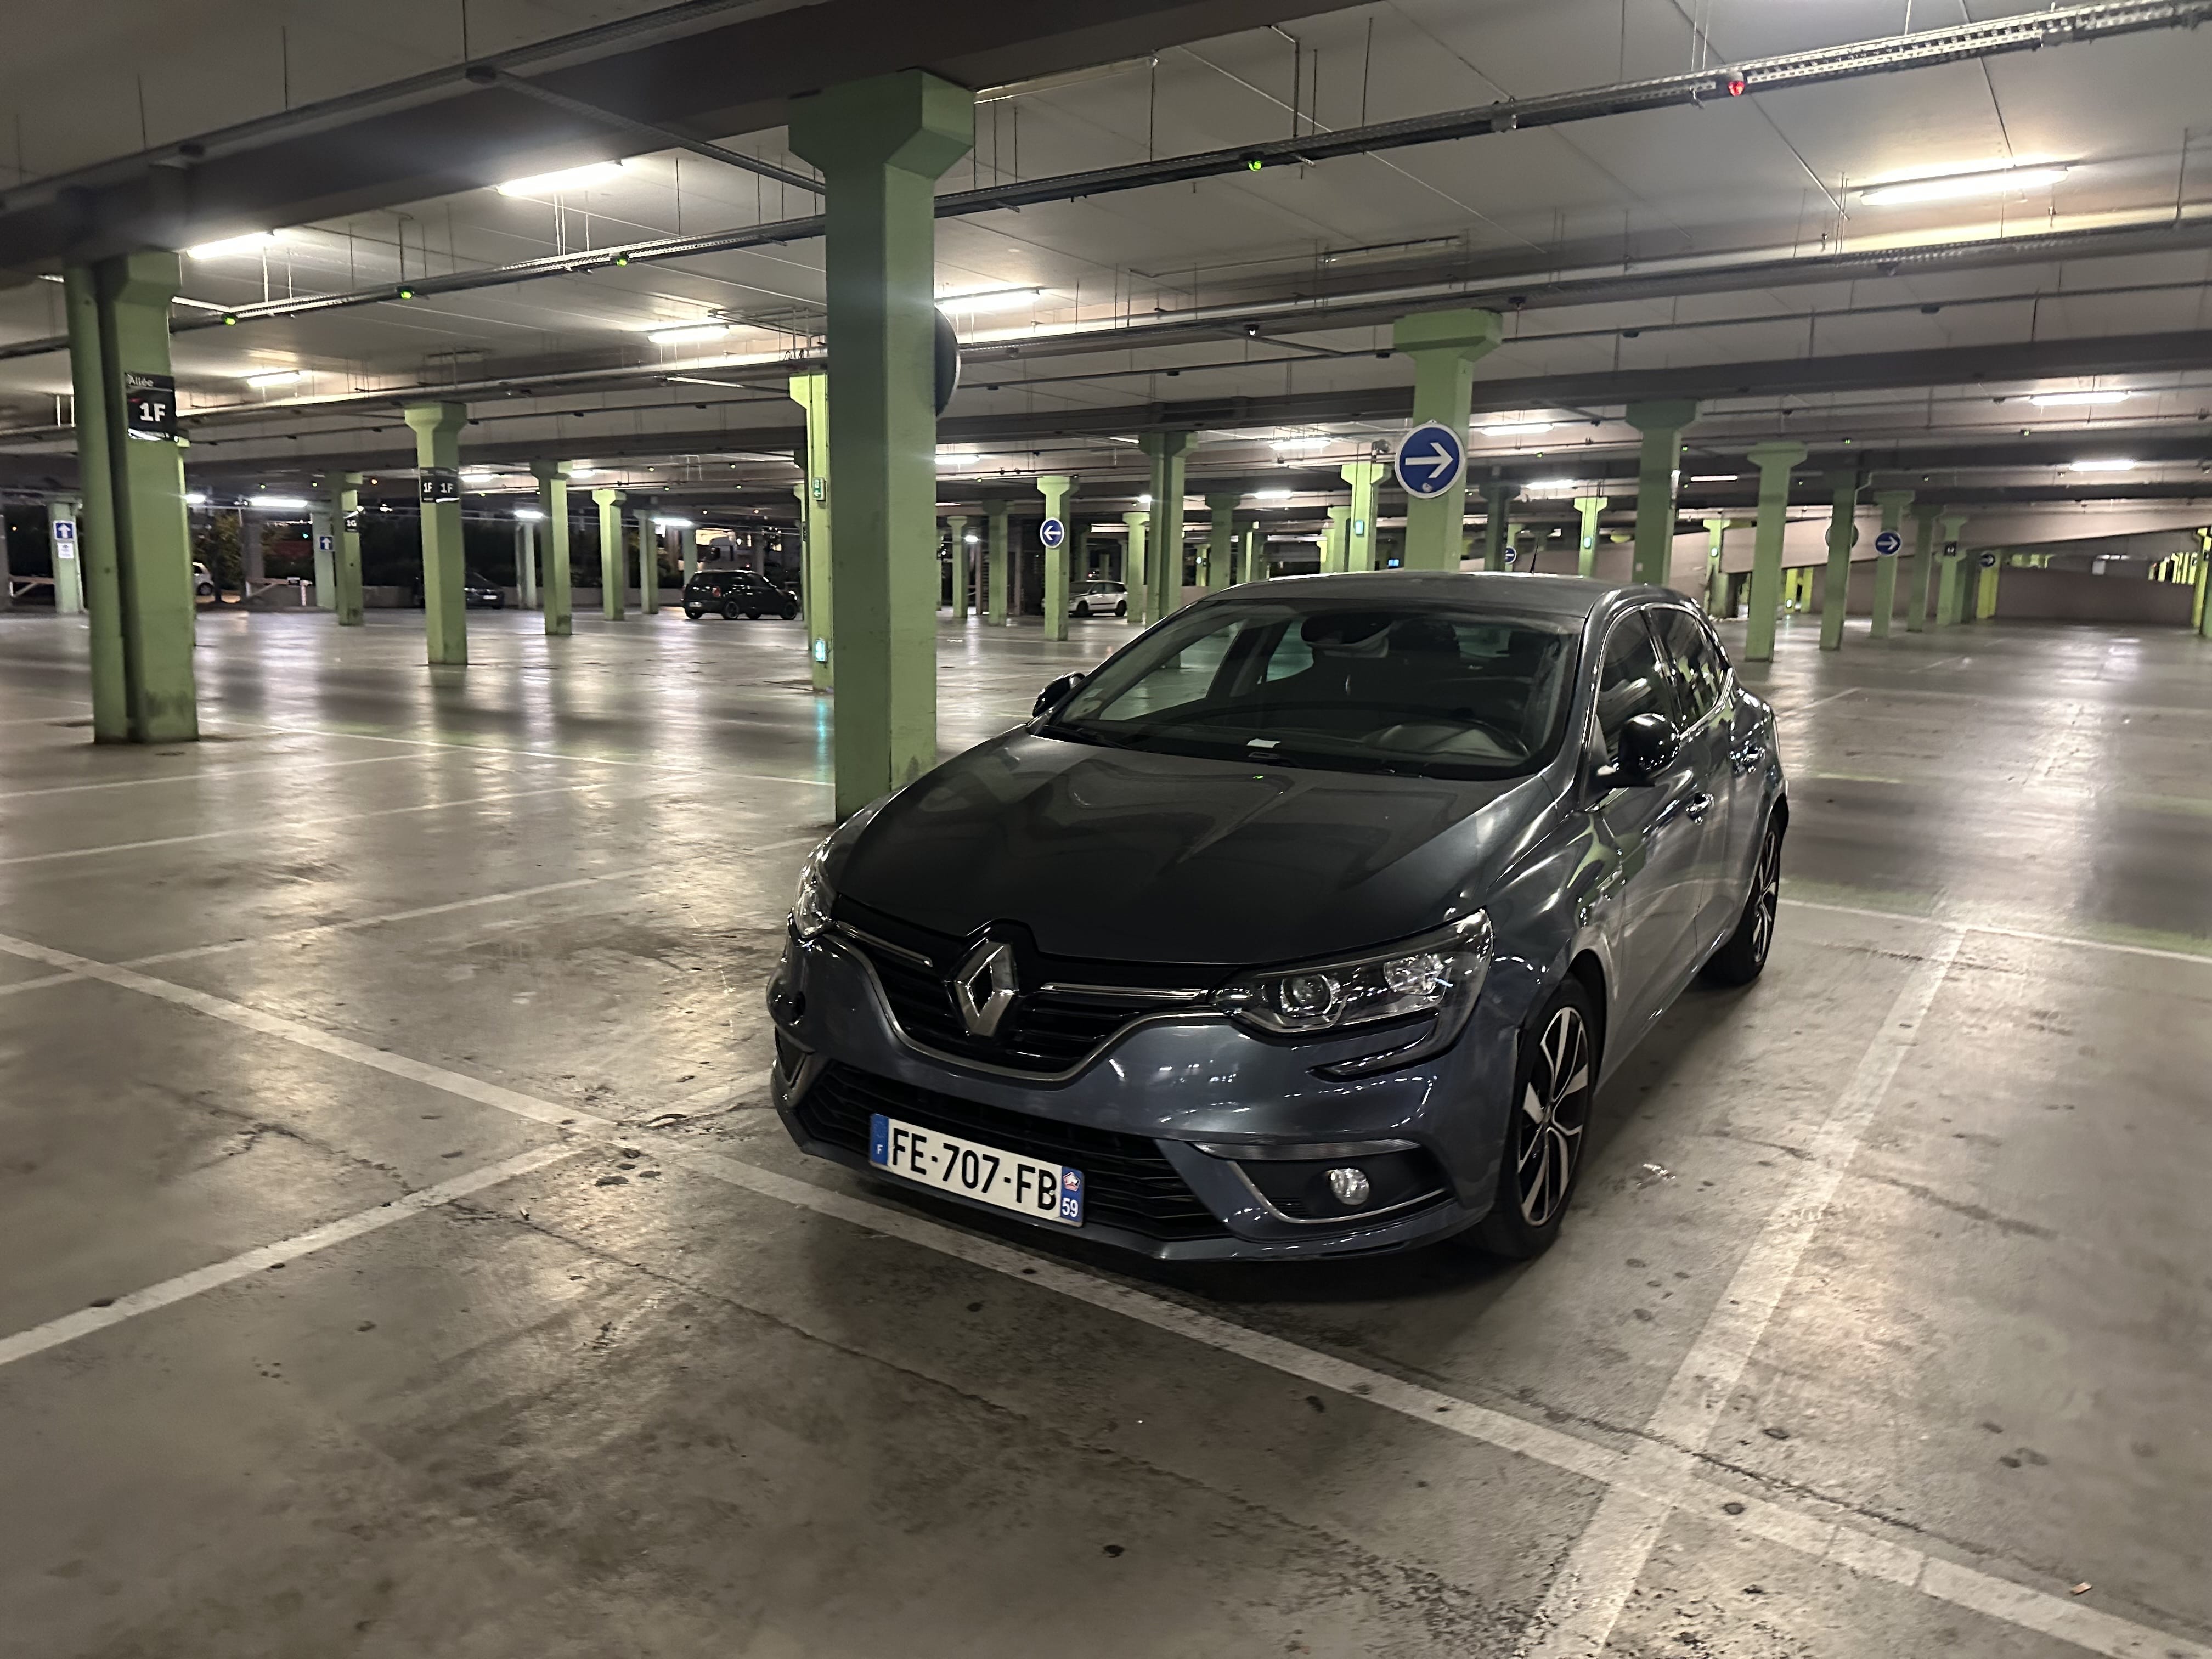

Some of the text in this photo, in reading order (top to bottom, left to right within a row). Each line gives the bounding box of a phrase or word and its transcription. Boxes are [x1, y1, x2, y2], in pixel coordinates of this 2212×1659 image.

[139, 402, 166, 421] 1F
[424, 482, 432, 493] 1F
[441, 483, 453, 493] 1F
[876, 1144, 883, 1155] F
[893, 1127, 1057, 1210] FE-707-FB
[1062, 1197, 1079, 1217] 59
